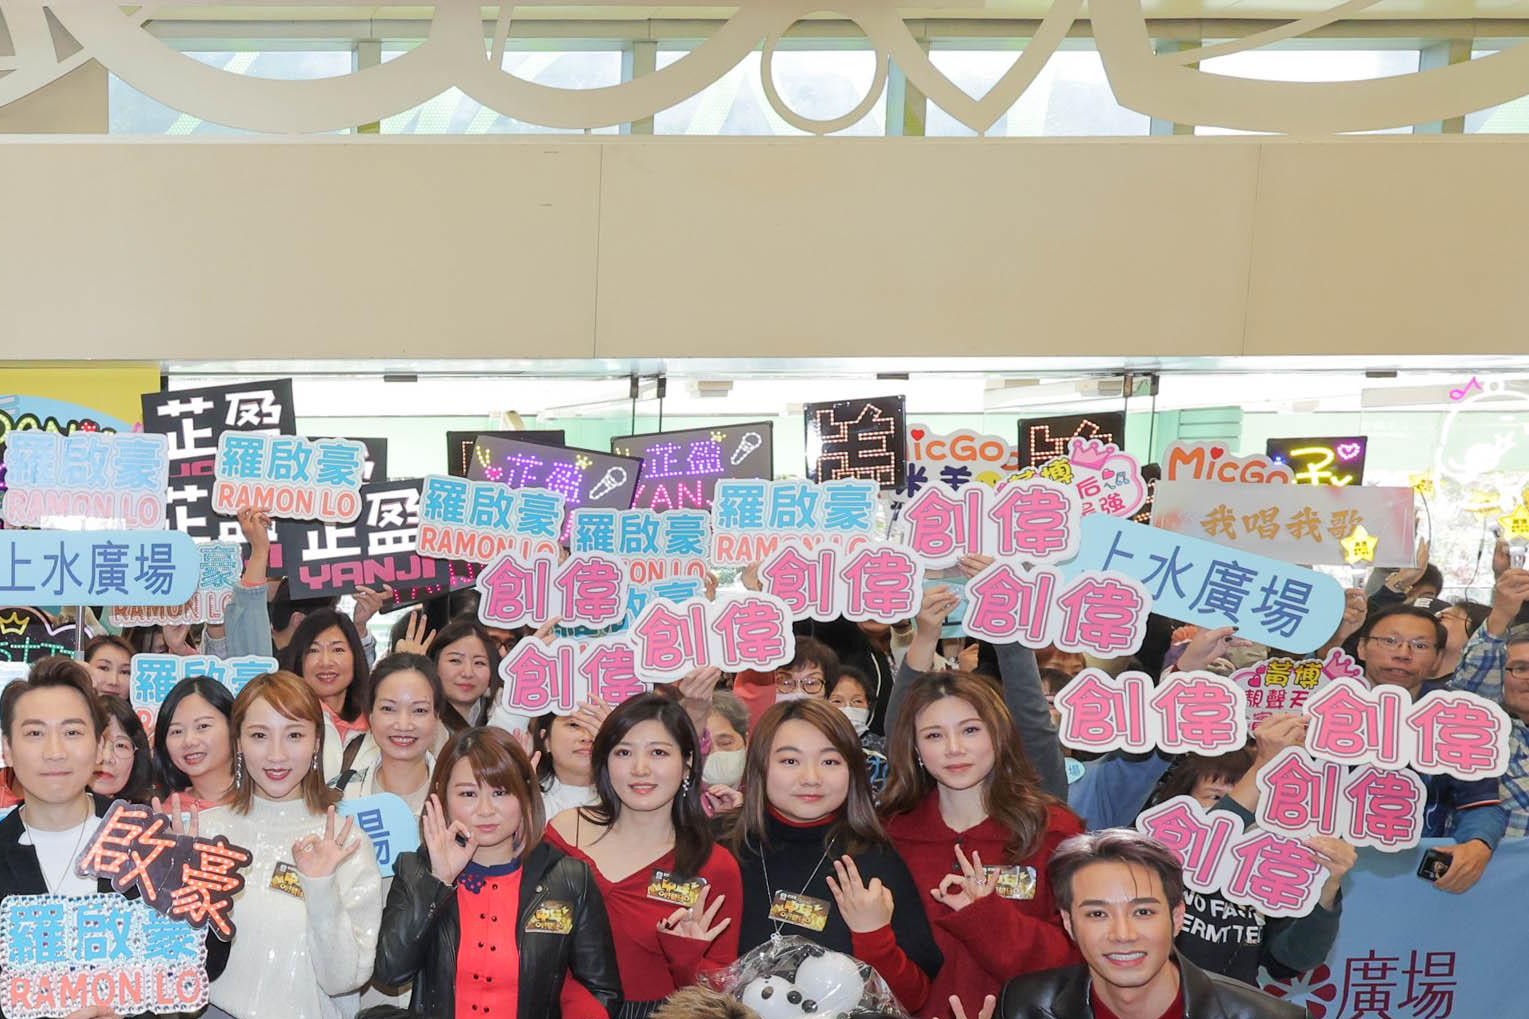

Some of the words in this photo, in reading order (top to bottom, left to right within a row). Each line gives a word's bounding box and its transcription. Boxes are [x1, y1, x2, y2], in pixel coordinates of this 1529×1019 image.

[223, 435, 362, 486] 羅啟豪
[906, 429, 1004, 462] icGo
[122, 493, 161, 528] LO
[218, 482, 313, 514] RAMON
[321, 490, 356, 518] LO
[424, 478, 561, 538] 羅啟豪
[719, 484, 873, 531] 羅啟豪
[909, 488, 1068, 557] 創偉
[1201, 504, 1364, 542] 我唱我歌
[576, 513, 705, 554] 羅啟豪
[485, 556, 621, 621] 創偉
[765, 549, 914, 615] 創偉
[972, 566, 1141, 651] 創偉
[1102, 530, 1314, 638] 上水廣場
[638, 599, 789, 668] 創偉
[509, 643, 644, 709] 創偉
[1062, 676, 1237, 748] 創偉
[1312, 685, 1501, 772] 創偉
[1264, 756, 1421, 845] 創偉
[81, 806, 250, 936] 啟豪
[10, 971, 142, 1010] RAMON
[157, 970, 202, 1004] LO
